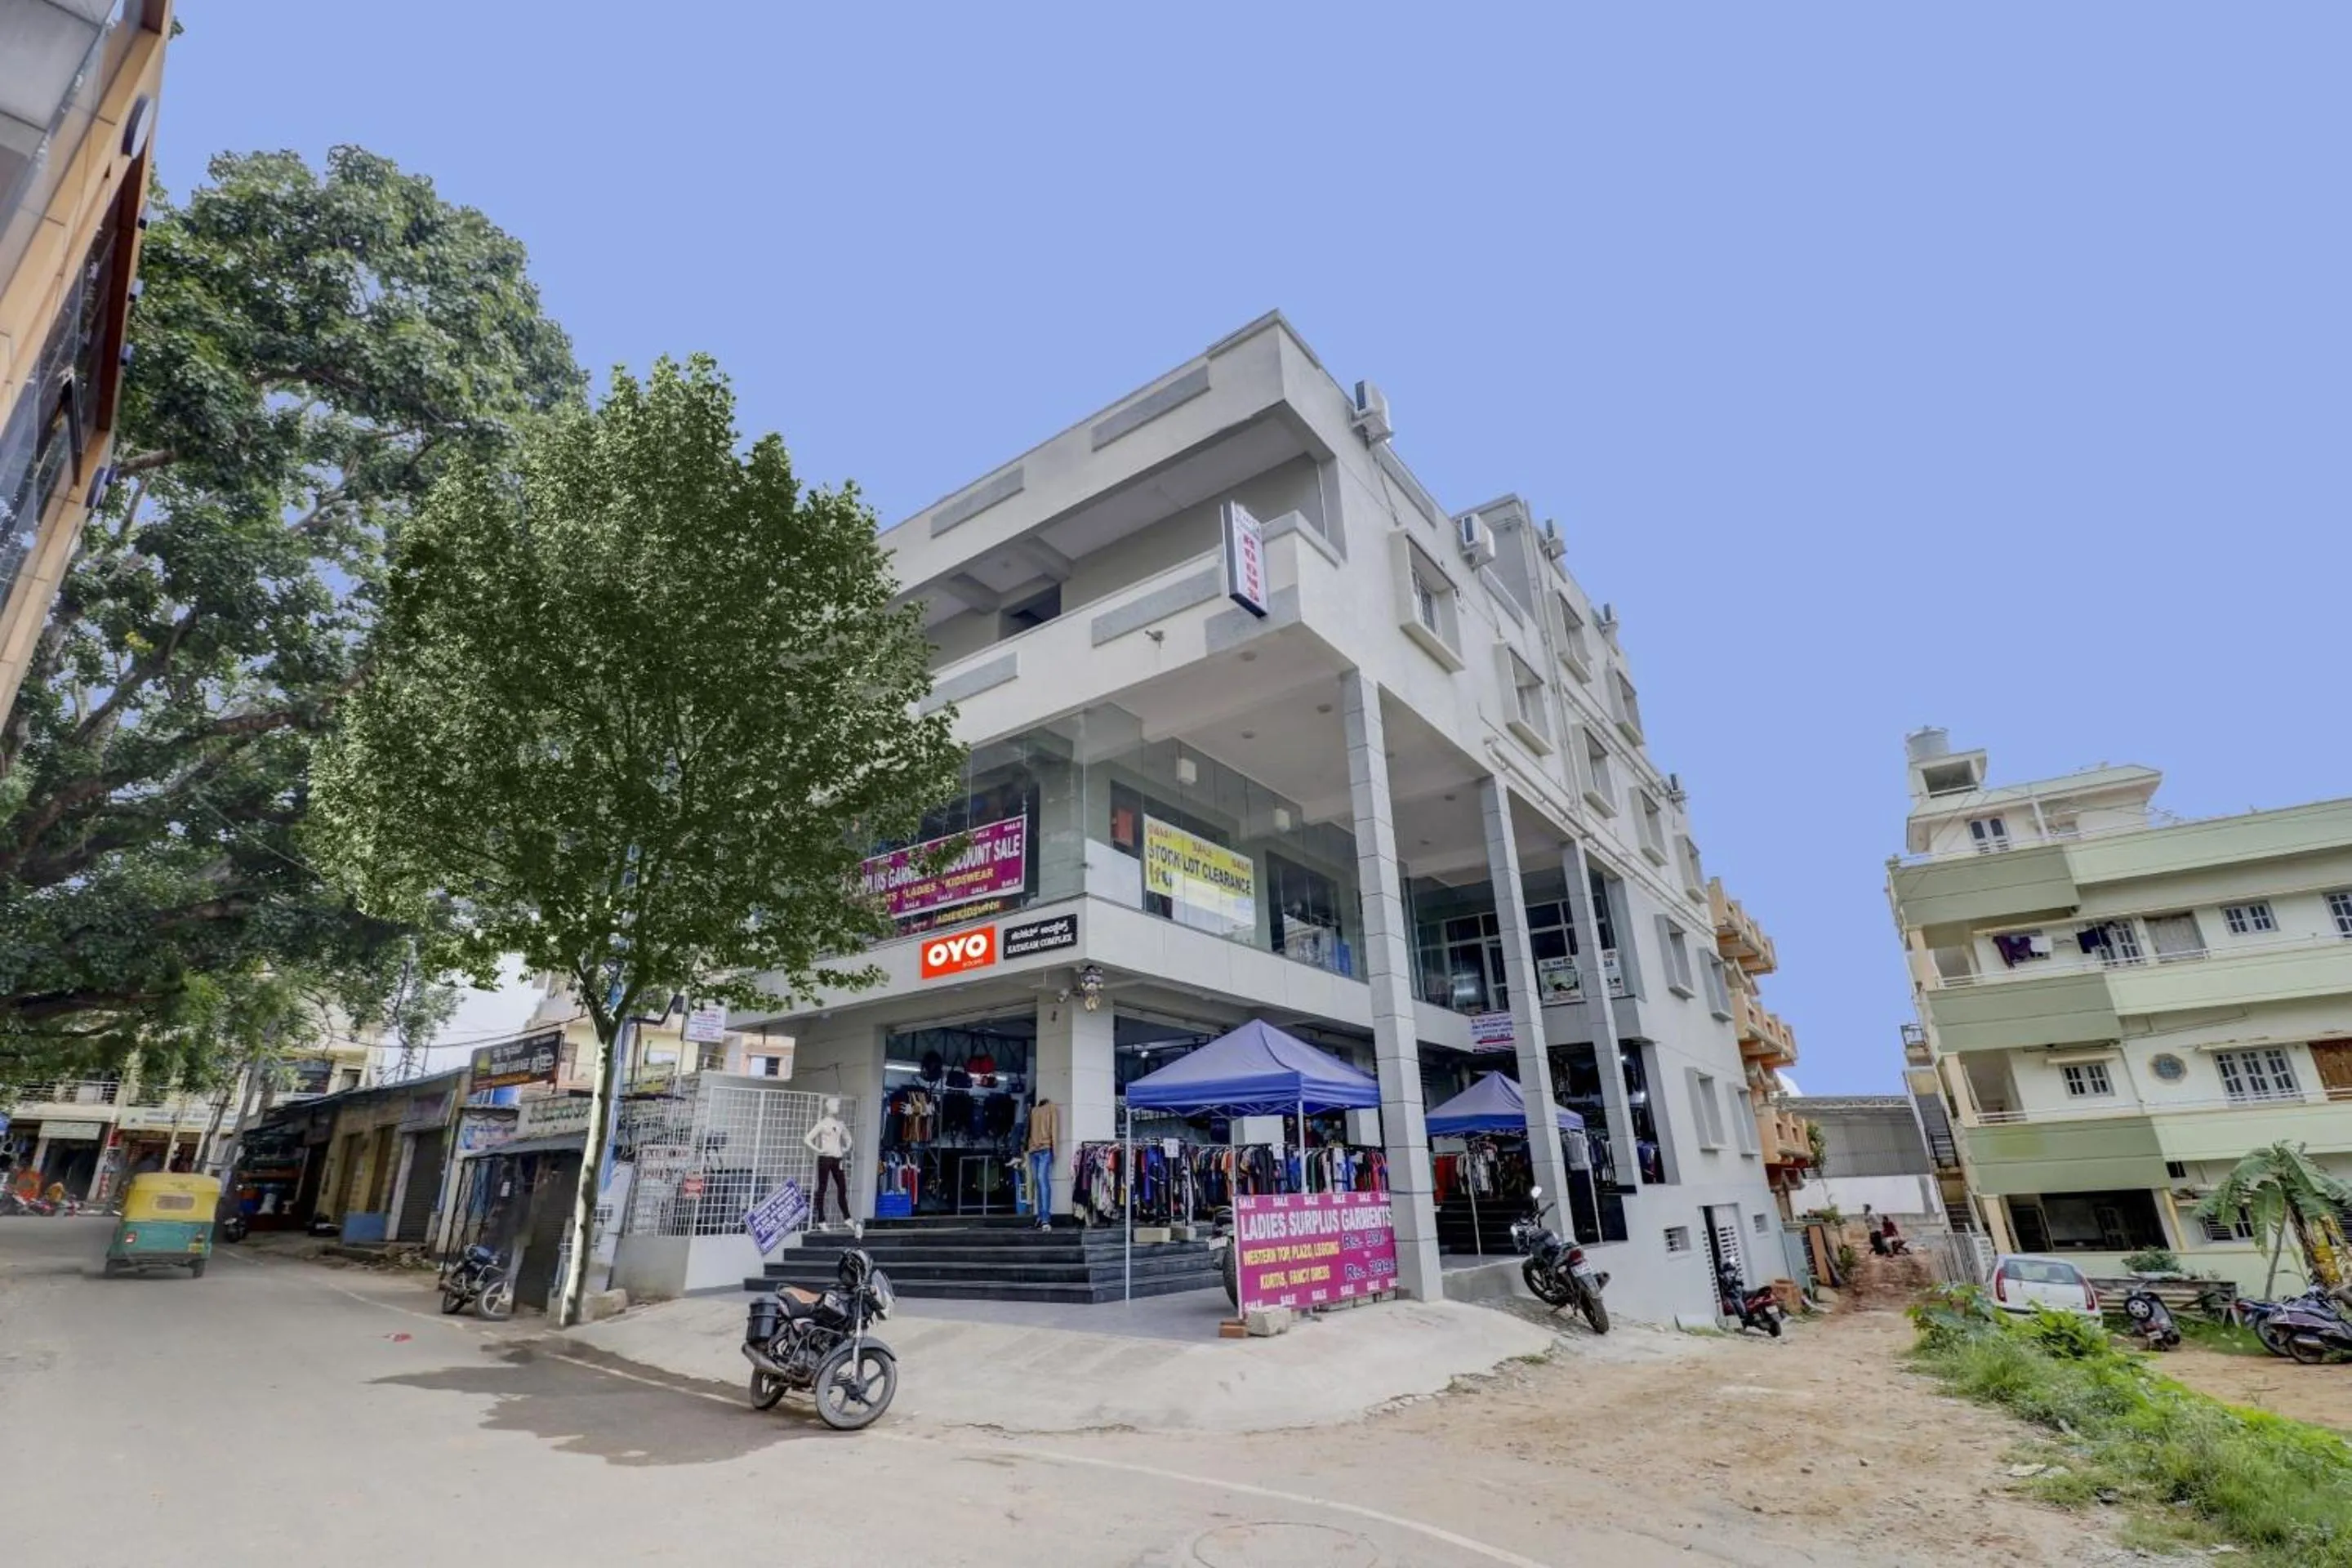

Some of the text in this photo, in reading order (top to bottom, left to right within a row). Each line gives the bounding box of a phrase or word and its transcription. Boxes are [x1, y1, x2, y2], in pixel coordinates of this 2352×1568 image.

[993, 833, 1021, 862] SALE
[1148, 845, 1181, 868] STOCK
[1202, 862, 1251, 895] CLEARANCE
[928, 933, 987, 967] OYO
[1039, 932, 1073, 947] COMPLEX
[1241, 1205, 1392, 1241] LADIES SURPLUS GARMENTS
